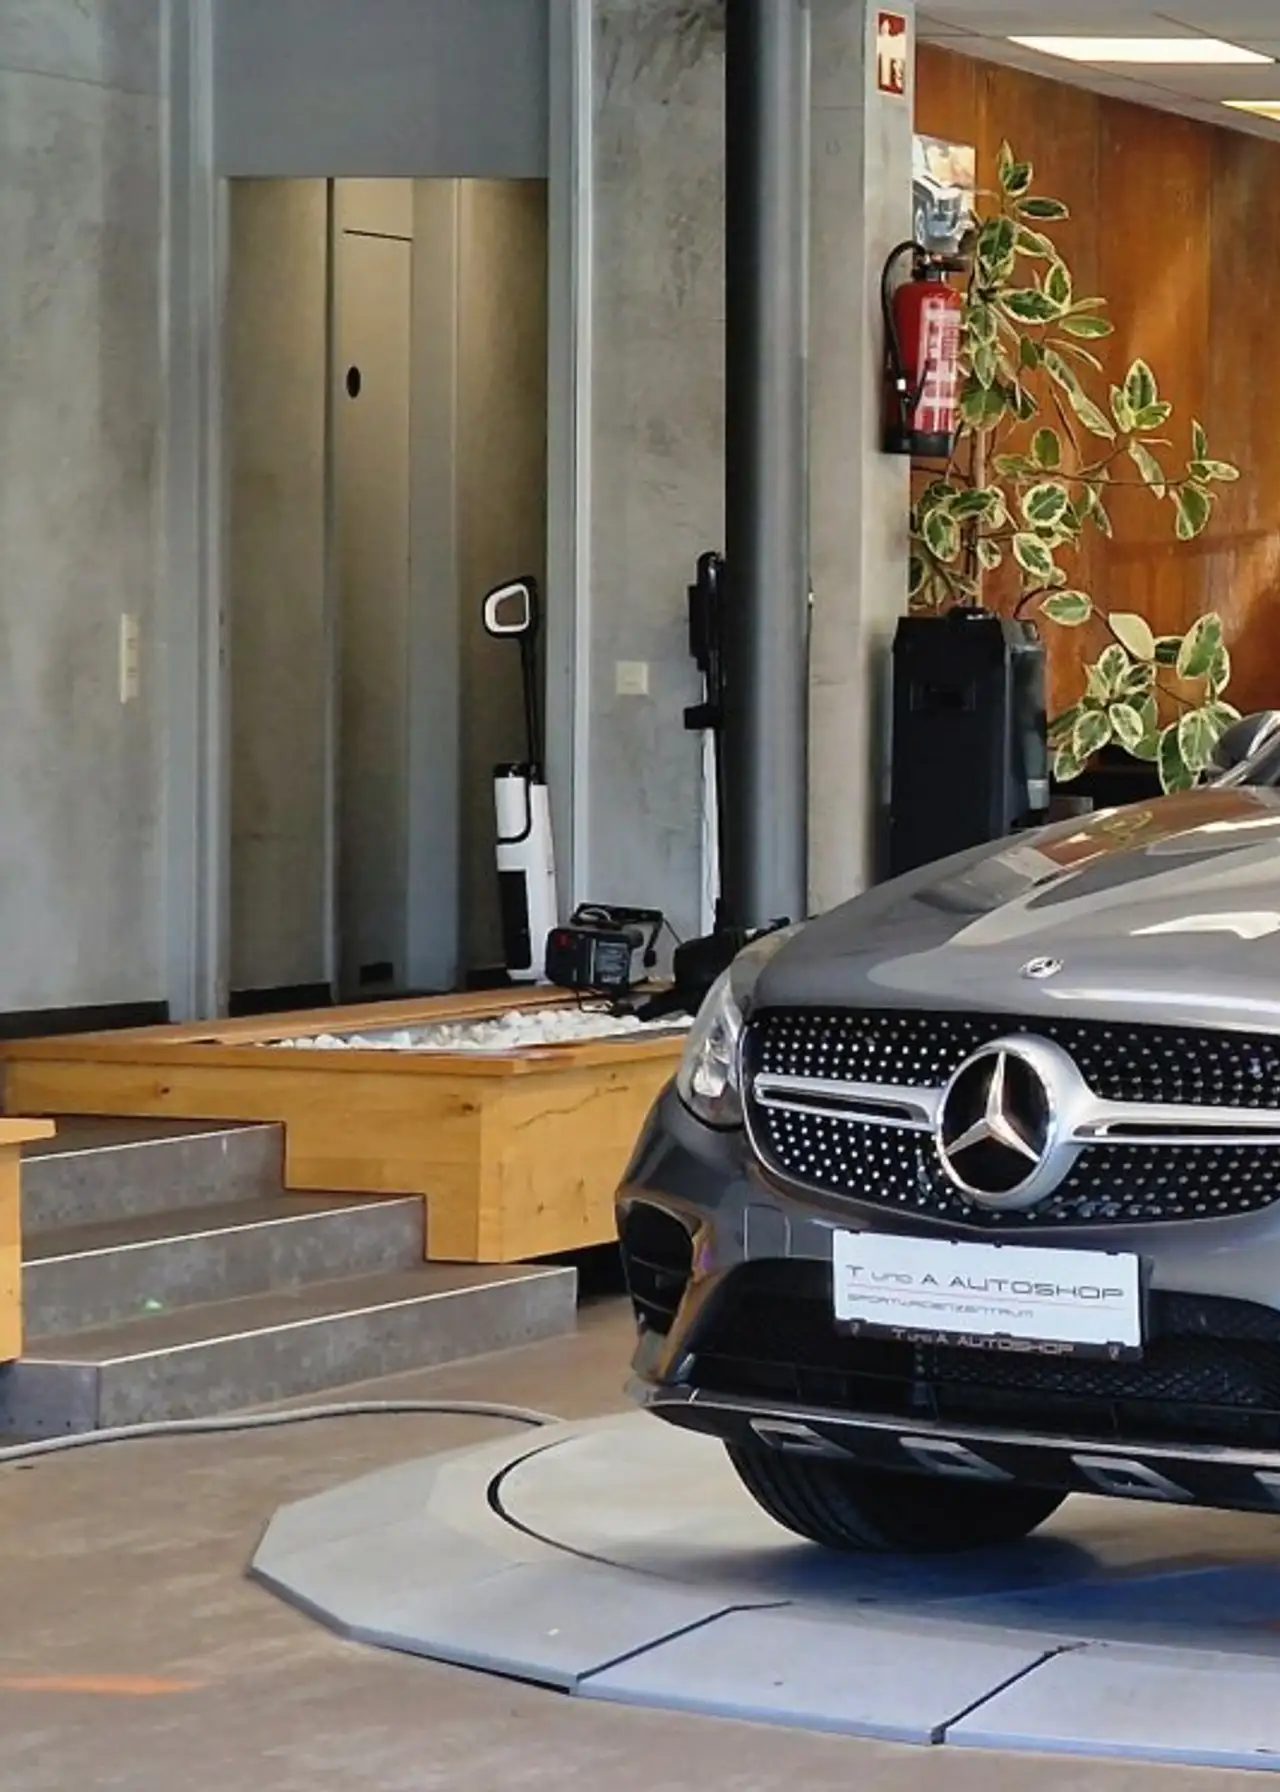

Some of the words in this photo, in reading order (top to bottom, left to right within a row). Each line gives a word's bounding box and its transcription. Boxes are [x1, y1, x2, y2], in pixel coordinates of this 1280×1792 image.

[846, 1265, 865, 1278] T
[921, 1273, 939, 1286] A
[949, 1275, 1124, 1300] AUTOSHOP
[892, 1328, 907, 1340] T
[936, 1334, 950, 1346] A
[957, 1335, 1075, 1355] AUTOSHOP
